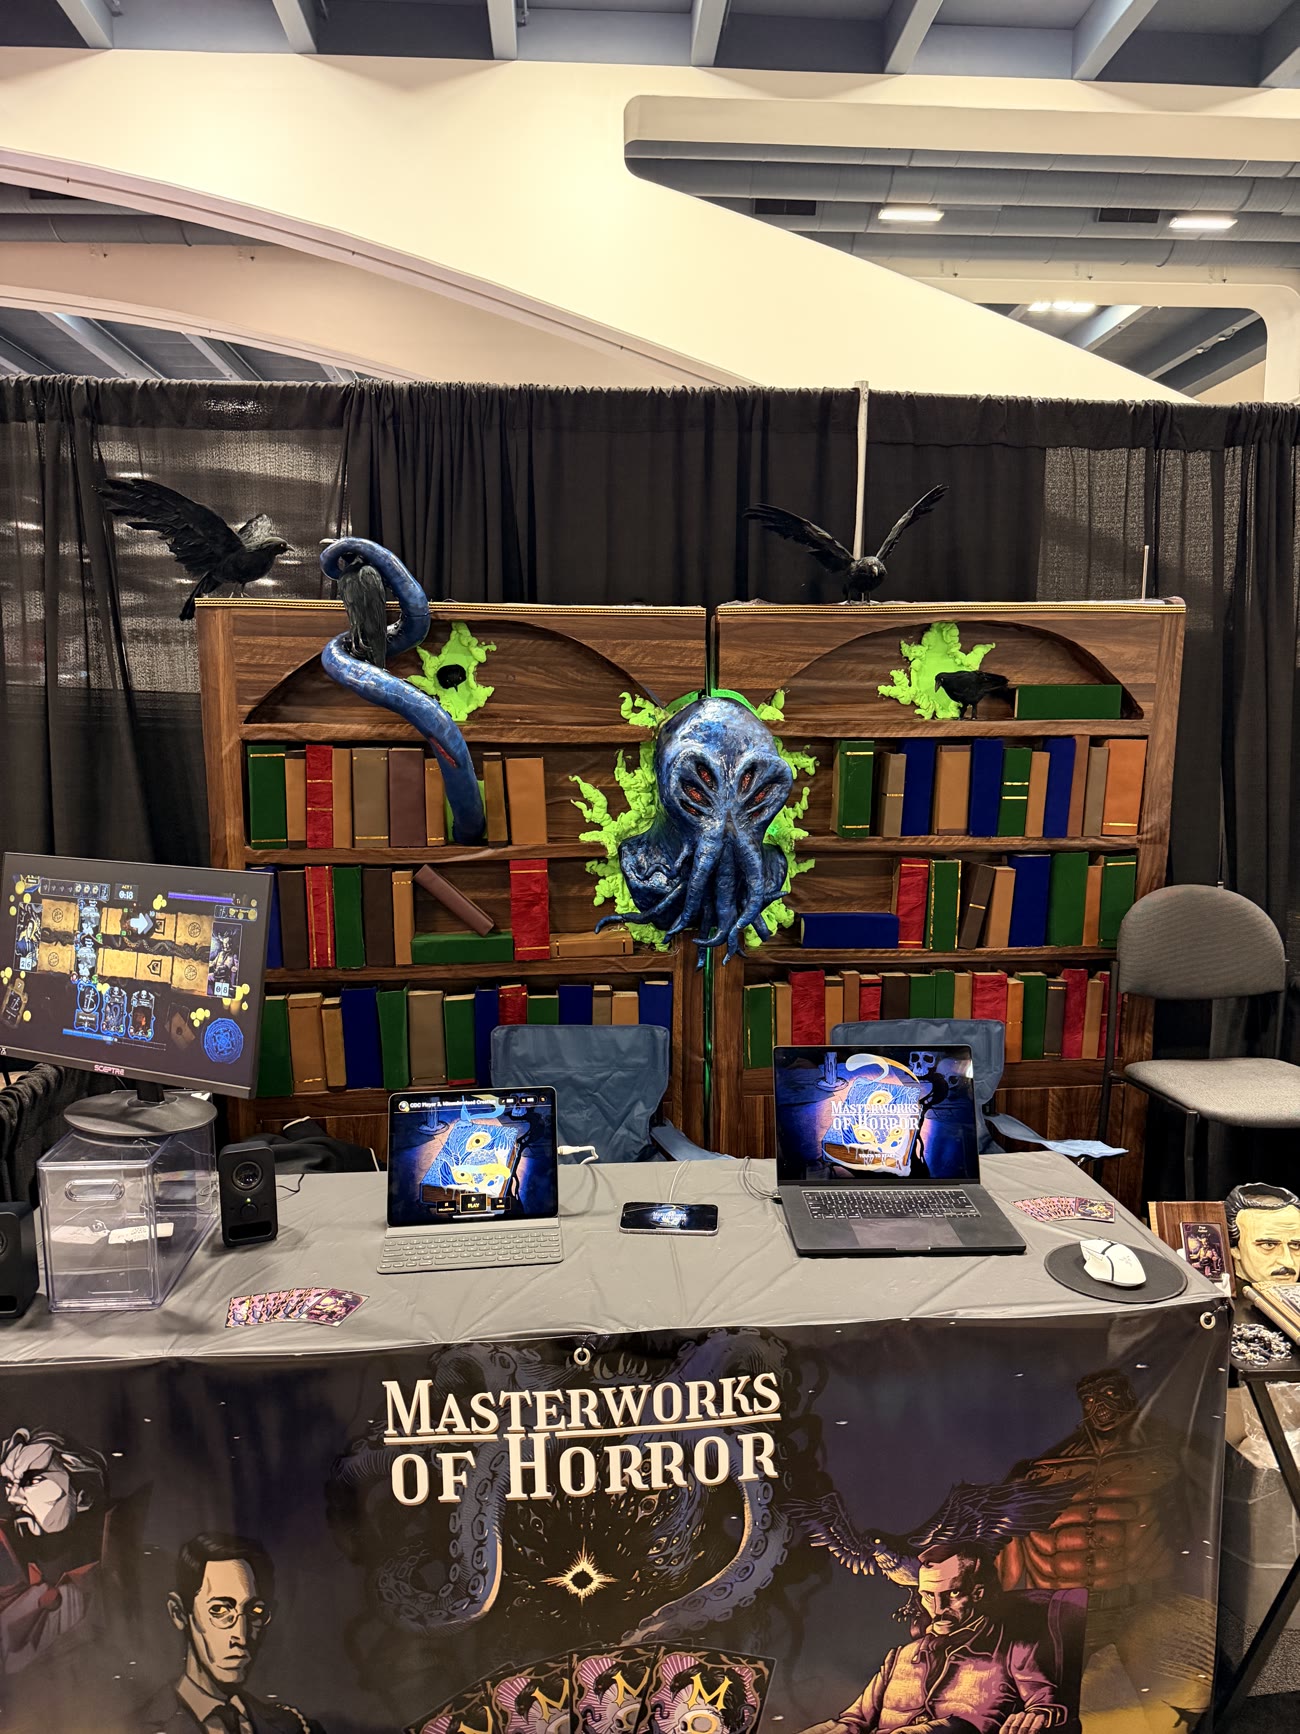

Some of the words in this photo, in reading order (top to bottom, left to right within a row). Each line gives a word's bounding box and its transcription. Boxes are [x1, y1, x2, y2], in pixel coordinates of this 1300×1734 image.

[94, 1064, 125, 1076] SCEPTRE
[830, 1100, 919, 1114] MASTERWORKS
[858, 1114, 919, 1130] HORROR
[382, 1372, 781, 1437] MASTERWORKS
[391, 1450, 477, 1507] OF
[503, 1432, 779, 1500] HORROR
